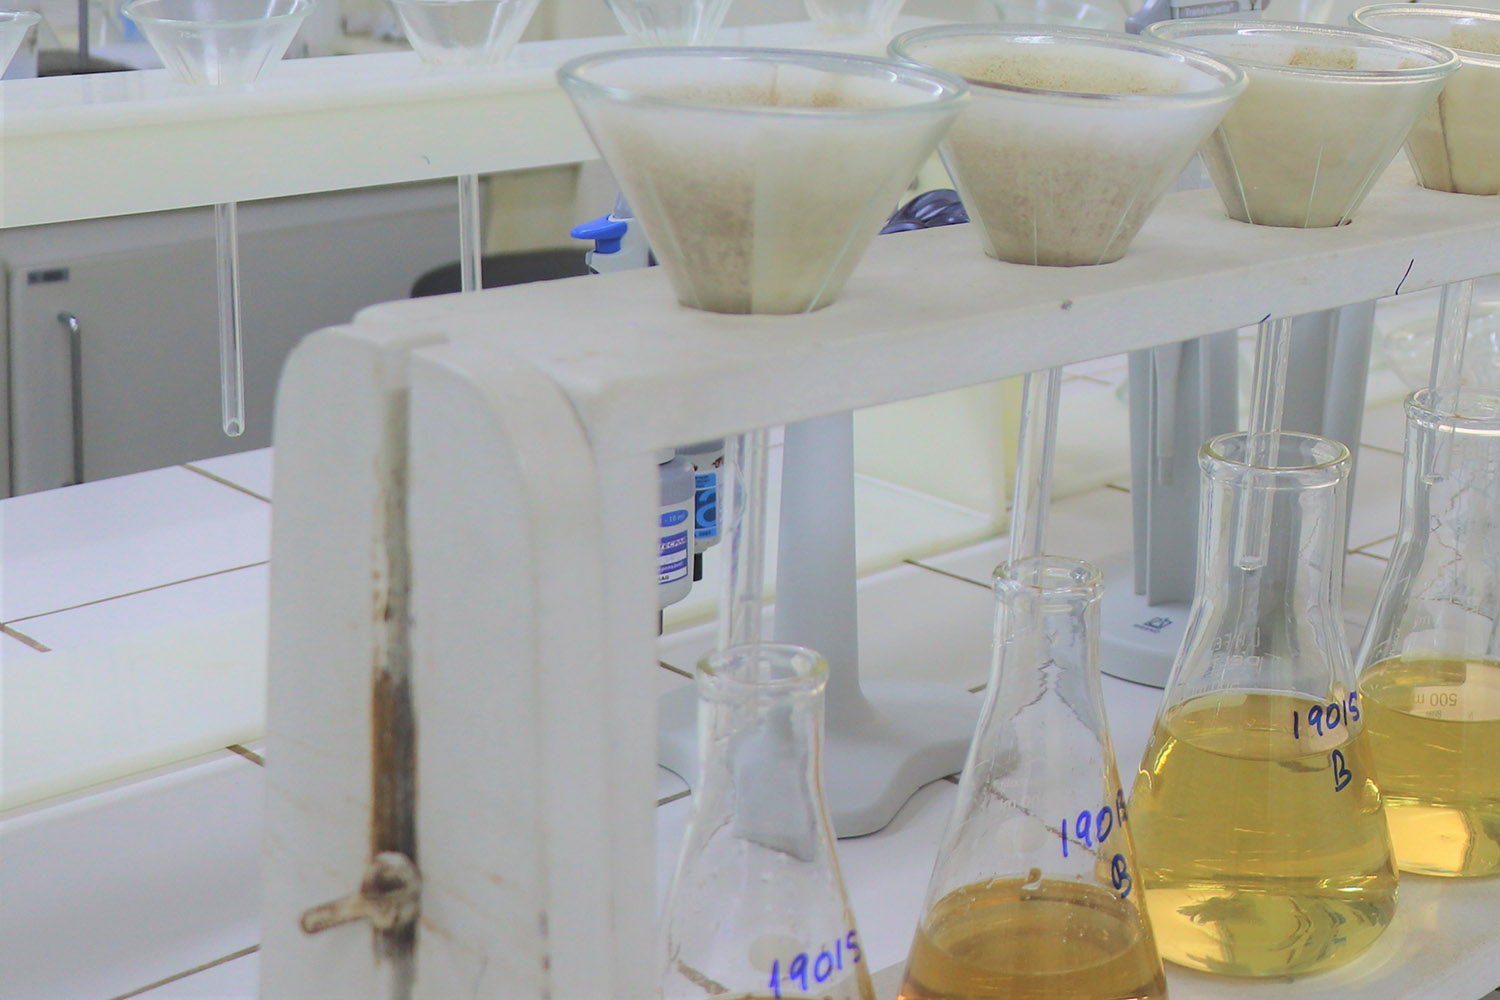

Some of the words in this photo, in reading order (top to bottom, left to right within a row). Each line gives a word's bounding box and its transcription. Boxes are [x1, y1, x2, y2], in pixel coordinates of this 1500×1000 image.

[1293, 690, 1361, 740] 19015
[1430, 692, 1458, 707] 500
[1331, 748, 1353, 793] B
[1111, 853, 1133, 899] B
[769, 929, 862, 1000] 19015
